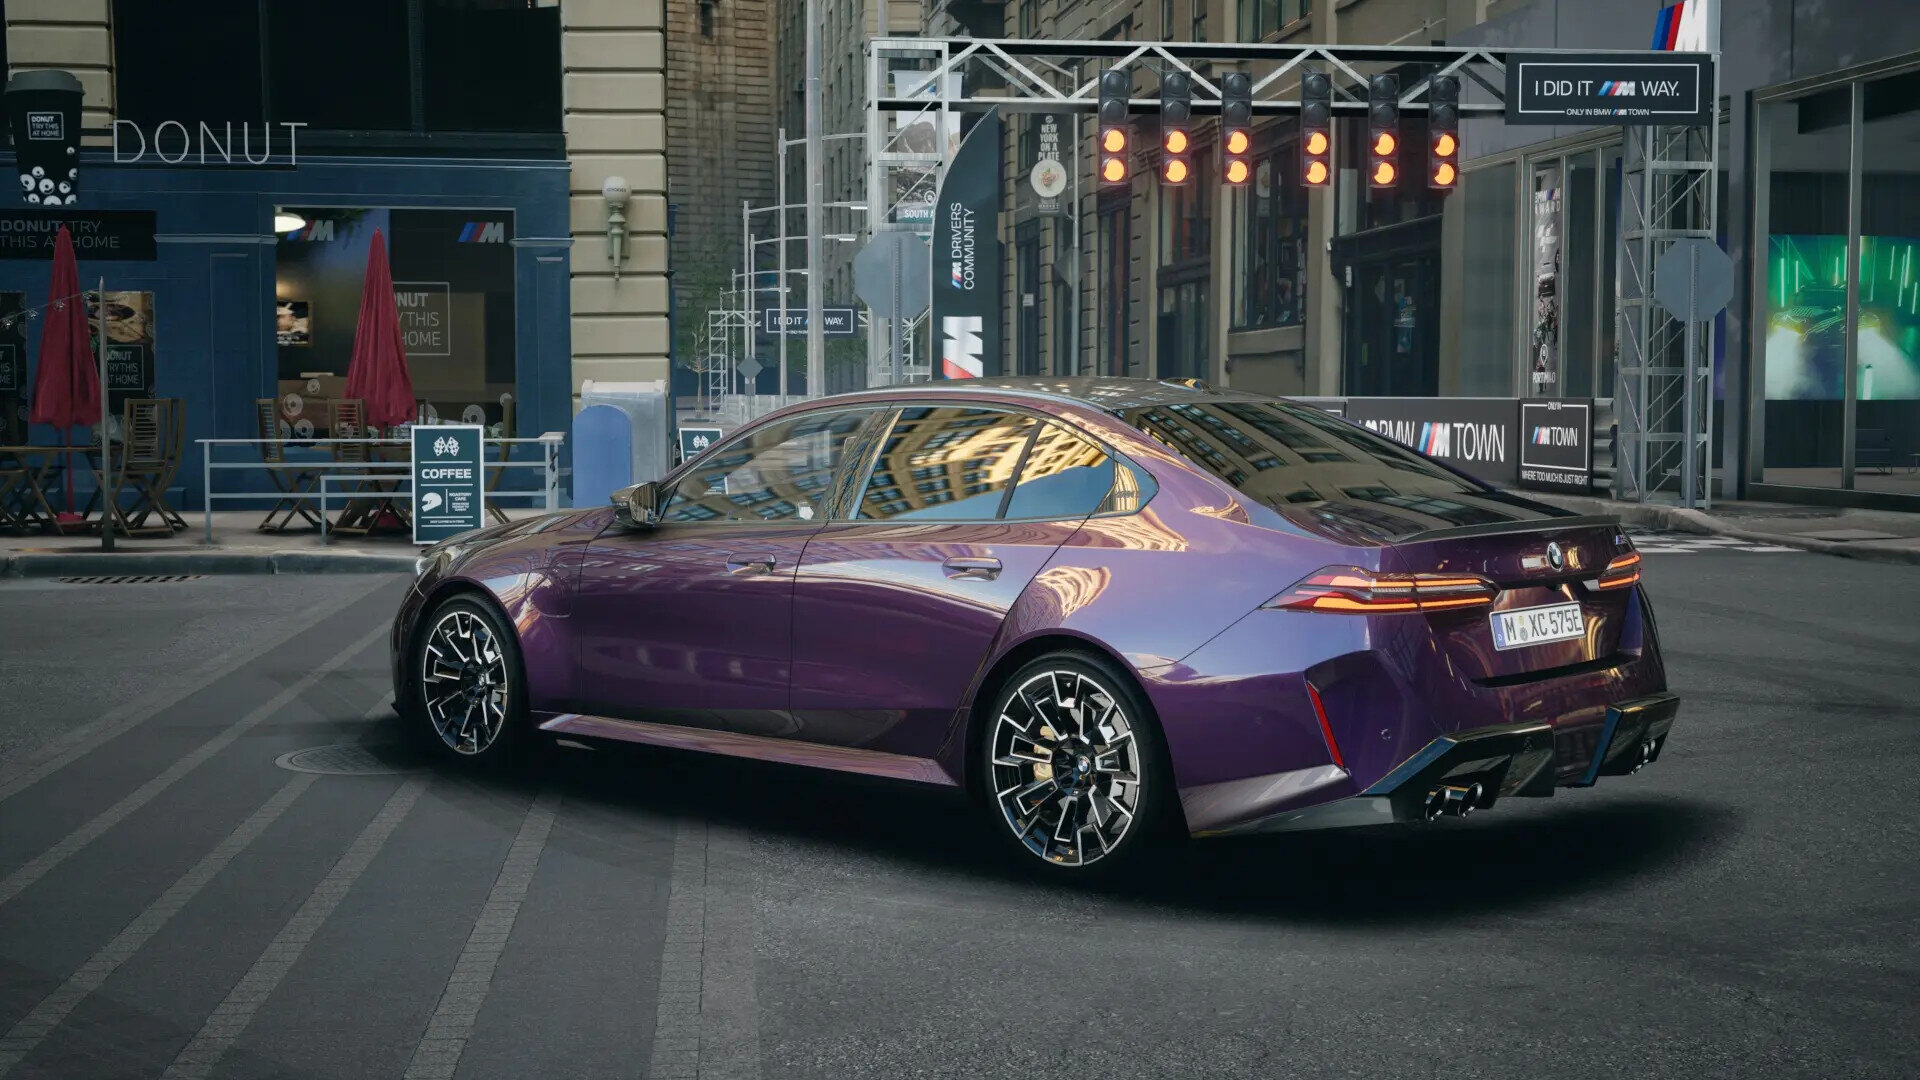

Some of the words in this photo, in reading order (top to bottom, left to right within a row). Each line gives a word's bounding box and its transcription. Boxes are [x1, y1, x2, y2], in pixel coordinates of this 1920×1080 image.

[1535, 80, 1539, 96] I
[1543, 80, 1573, 96] DID
[1577, 80, 1594, 96] IT
[1641, 80, 1680, 97] WAY.
[1566, 108, 1584, 116] ONLY
[1585, 108, 1592, 116] IN
[1593, 108, 1611, 116] BMW
[1628, 108, 1650, 116] TOWN
[31, 115, 54, 123] DONUT
[1041, 123, 1058, 133] NEW
[112, 119, 308, 166] DONUT
[1040, 133, 1059, 143] YORK
[1041, 143, 1051, 152] ON
[1052, 143, 1058, 152] A
[1038, 151, 1060, 161] PLATE
[904, 209, 929, 219] SOUTH
[65, 220, 102, 233] TRY
[951, 202, 962, 258] DRIVERS
[0, 235, 38, 249] THIS
[963, 208, 975, 290] COMMUNITY
[394, 292, 429, 308] NUT
[404, 311, 440, 327] THIS
[794, 316, 803, 325] IT
[1453, 422, 1505, 463] TOWN
[1551, 427, 1578, 447] TOWN
[421, 468, 472, 479] COFFEE
[1504, 617, 1516, 641] M
[1528, 613, 1548, 637] XC
[1549, 608, 1582, 635] 575E
